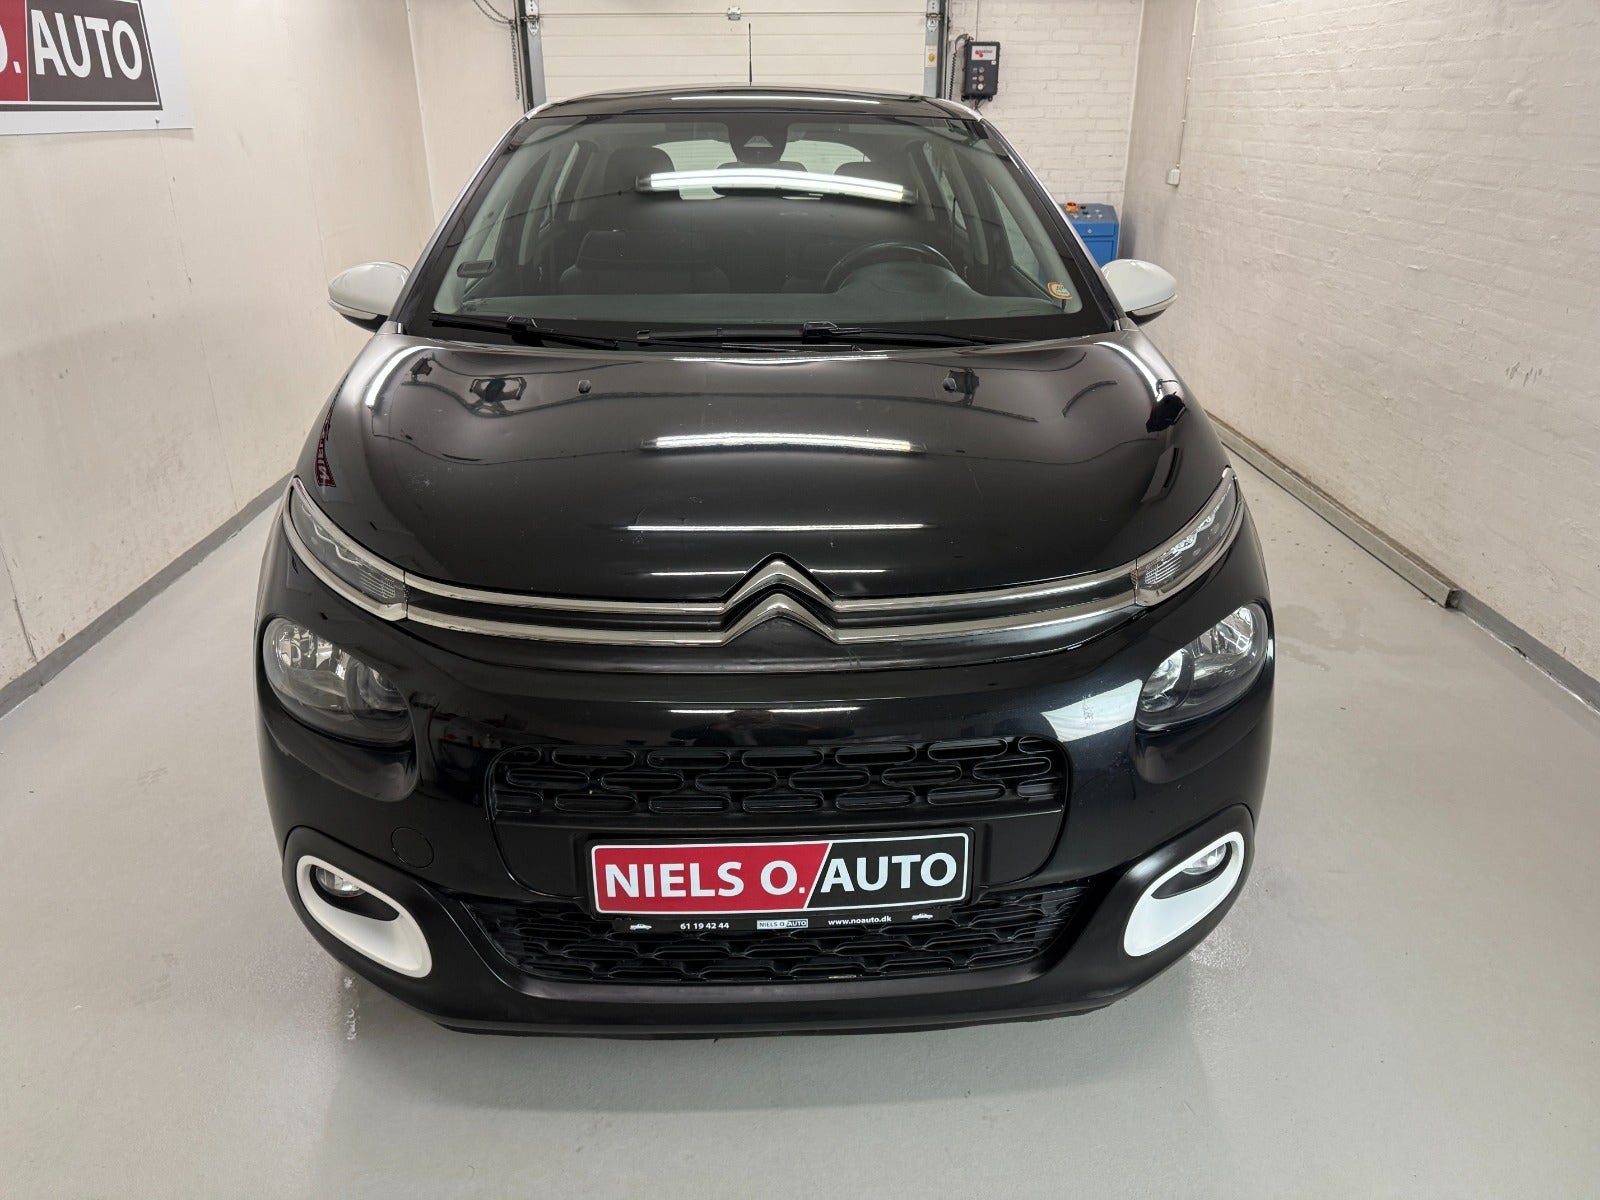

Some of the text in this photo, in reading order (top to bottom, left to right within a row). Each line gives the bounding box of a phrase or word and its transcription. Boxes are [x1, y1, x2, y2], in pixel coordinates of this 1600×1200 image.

[30, 9, 143, 80] AUTO
[605, 852, 957, 898] NIELS O. AUTO
[680, 922, 691, 930] 61
[693, 922, 704, 930] 19
[787, 920, 807, 928] AUTO
[828, 915, 892, 926] www.noauto.dk
